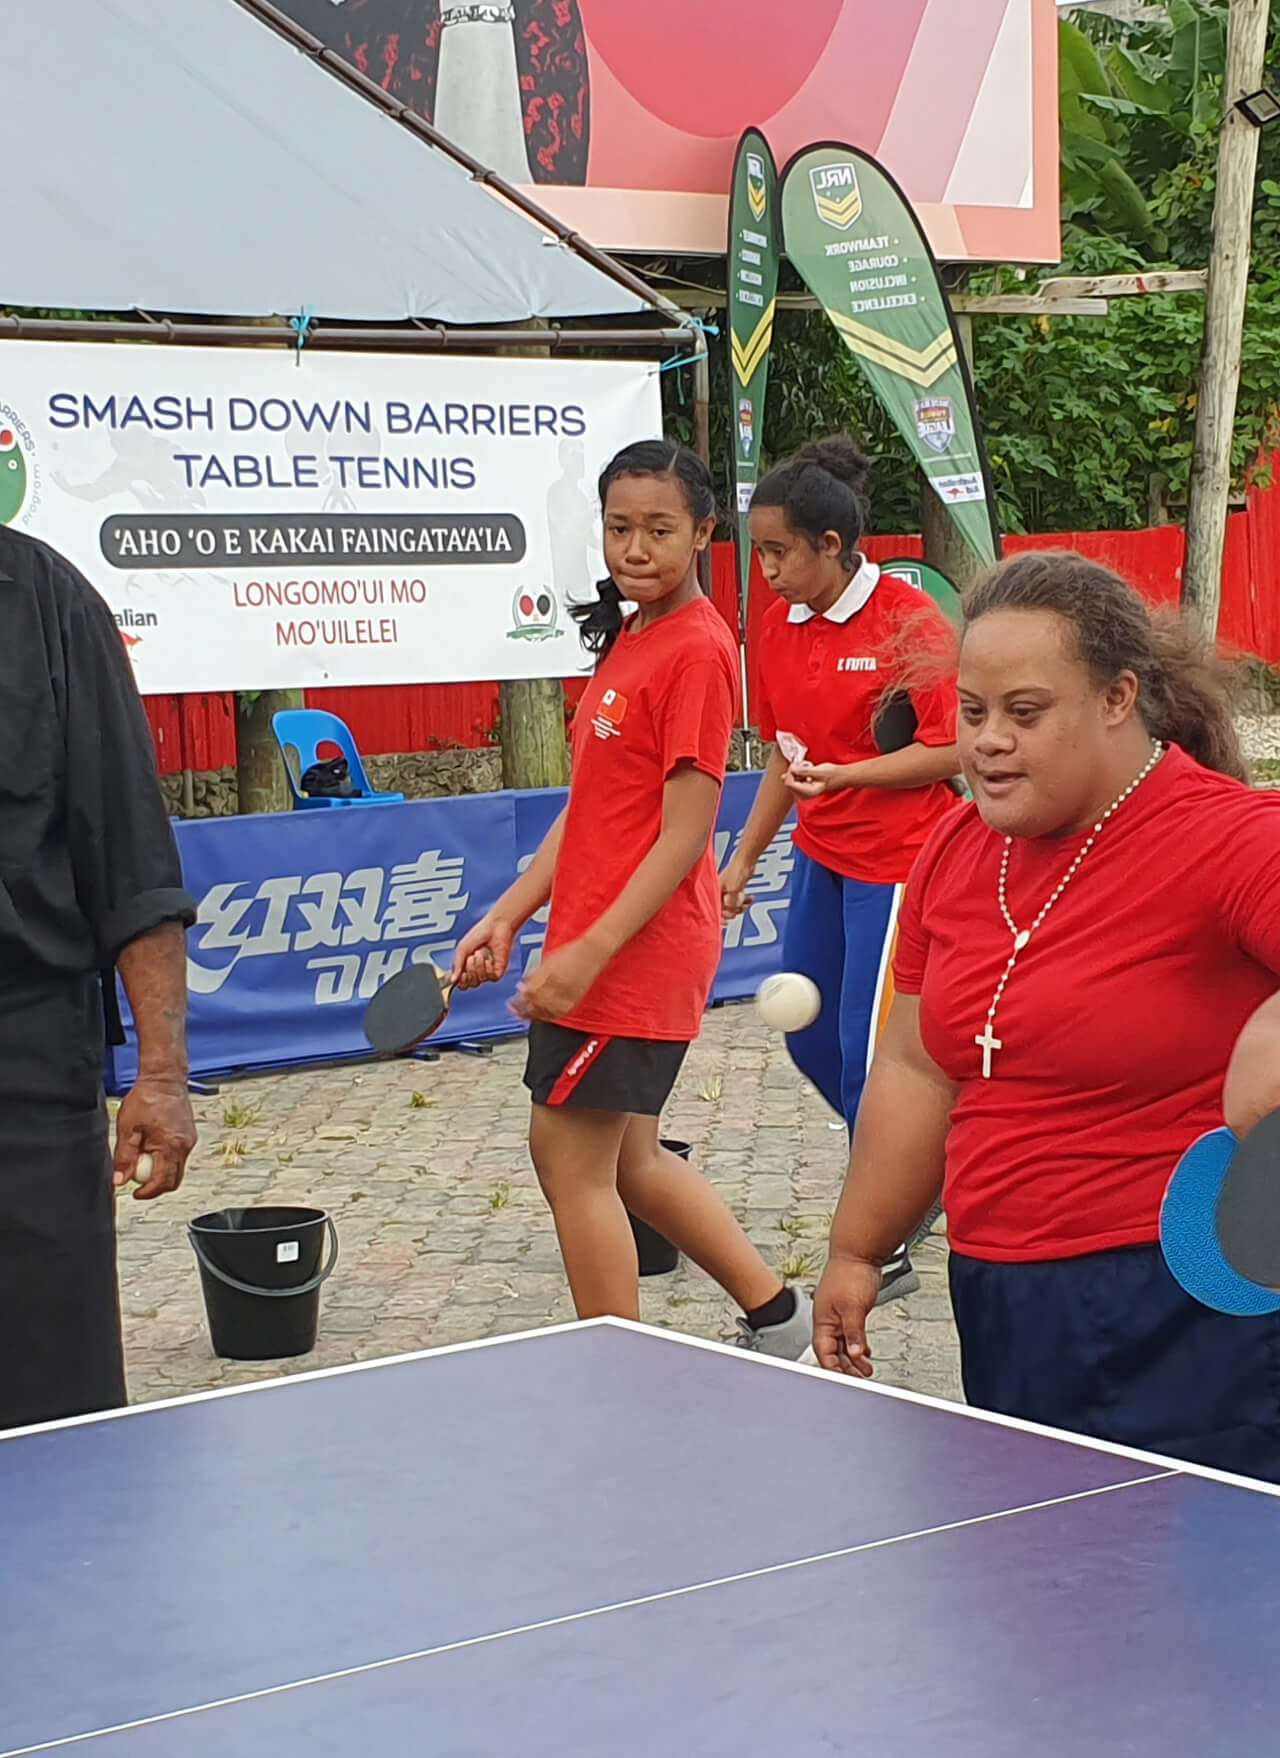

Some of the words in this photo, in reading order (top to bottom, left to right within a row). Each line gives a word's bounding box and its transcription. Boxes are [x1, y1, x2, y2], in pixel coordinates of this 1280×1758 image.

[49, 393, 213, 430] SMASH
[228, 398, 370, 433] DOWN
[386, 401, 586, 437] BARRIERS
[173, 454, 318, 488] TABLE
[328, 456, 476, 489] TENNIS
[223, 528, 242, 554] E
[249, 528, 334, 554] KAKAI
[233, 579, 384, 607] LONGOMO'UI
[391, 579, 426, 604] MO
[276, 618, 398, 646] MO'UILELEI
